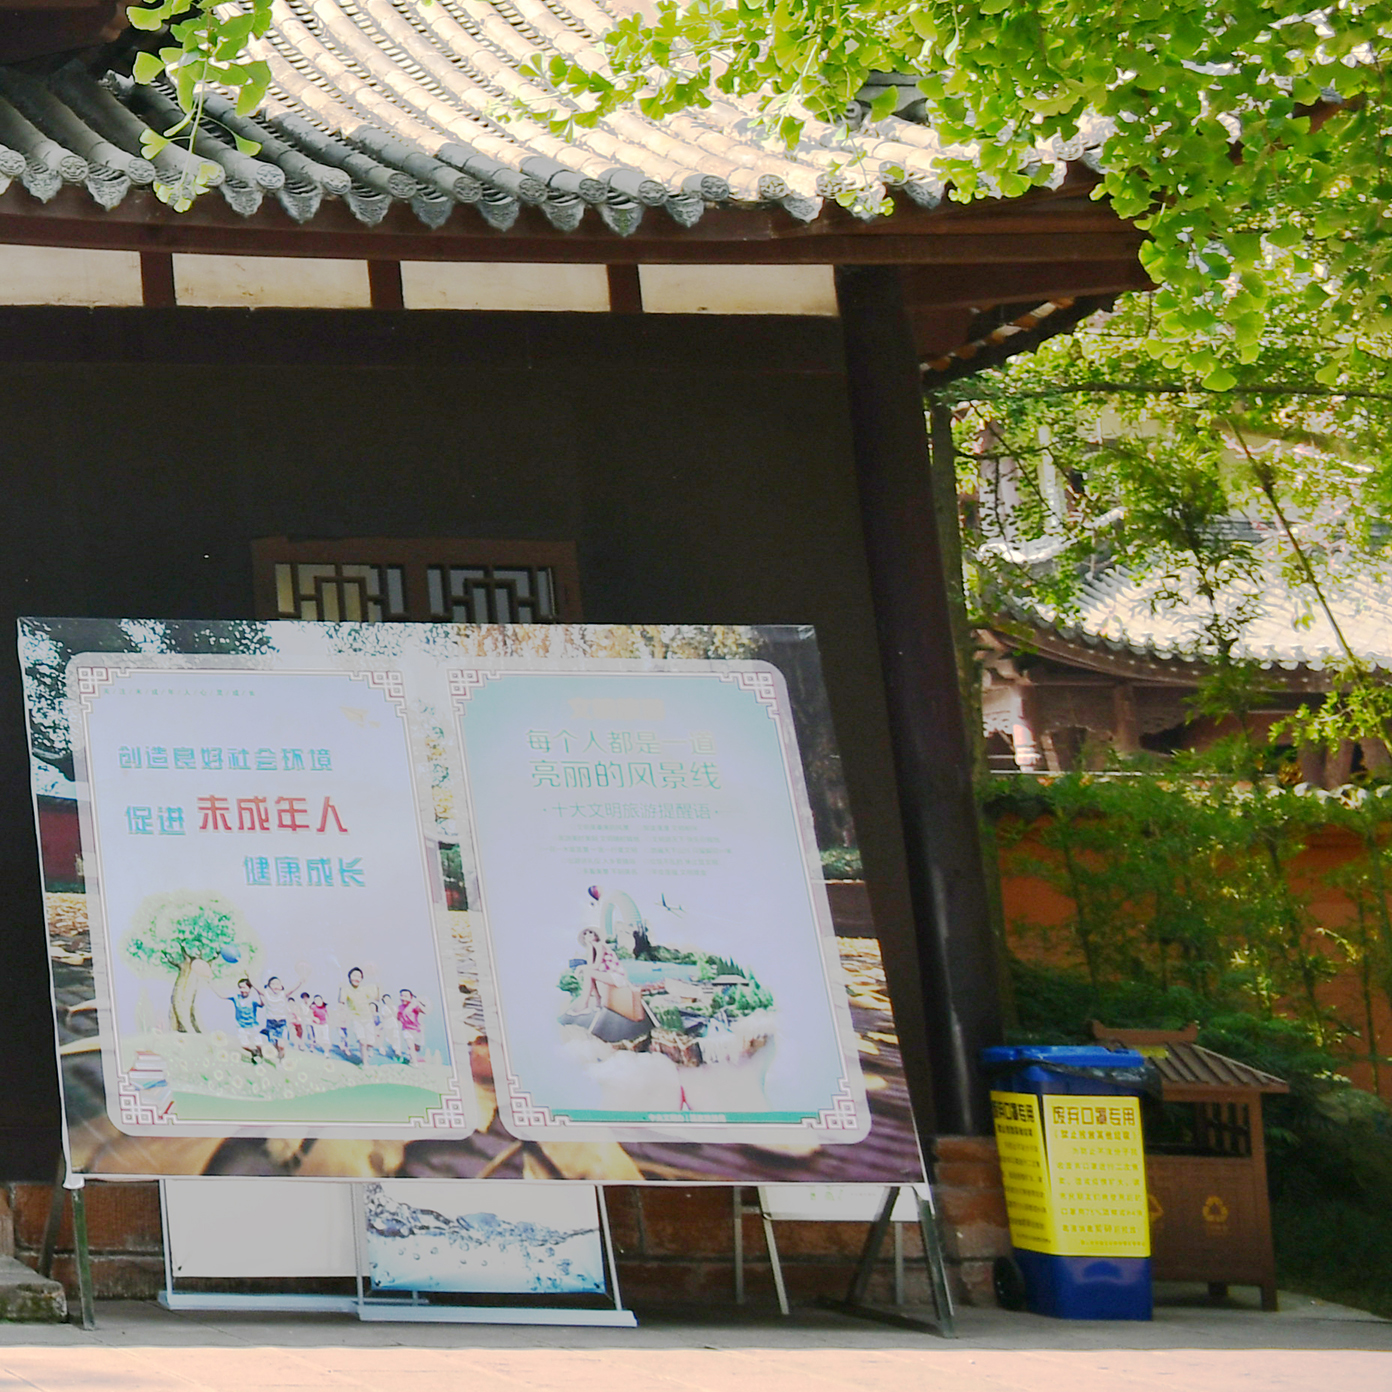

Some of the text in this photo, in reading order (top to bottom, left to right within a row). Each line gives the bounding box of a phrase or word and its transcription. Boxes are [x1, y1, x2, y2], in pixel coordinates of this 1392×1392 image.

[526, 729, 716, 756] 每个人都是一道
[118, 746, 333, 771] 创造良好社会环境
[528, 759, 721, 790] 亮丽的风景线
[124, 794, 349, 836] 促进 未成年人
[243, 855, 366, 888] 健康成长
[1052, 1106, 1135, 1126] 废弃口罩专用
